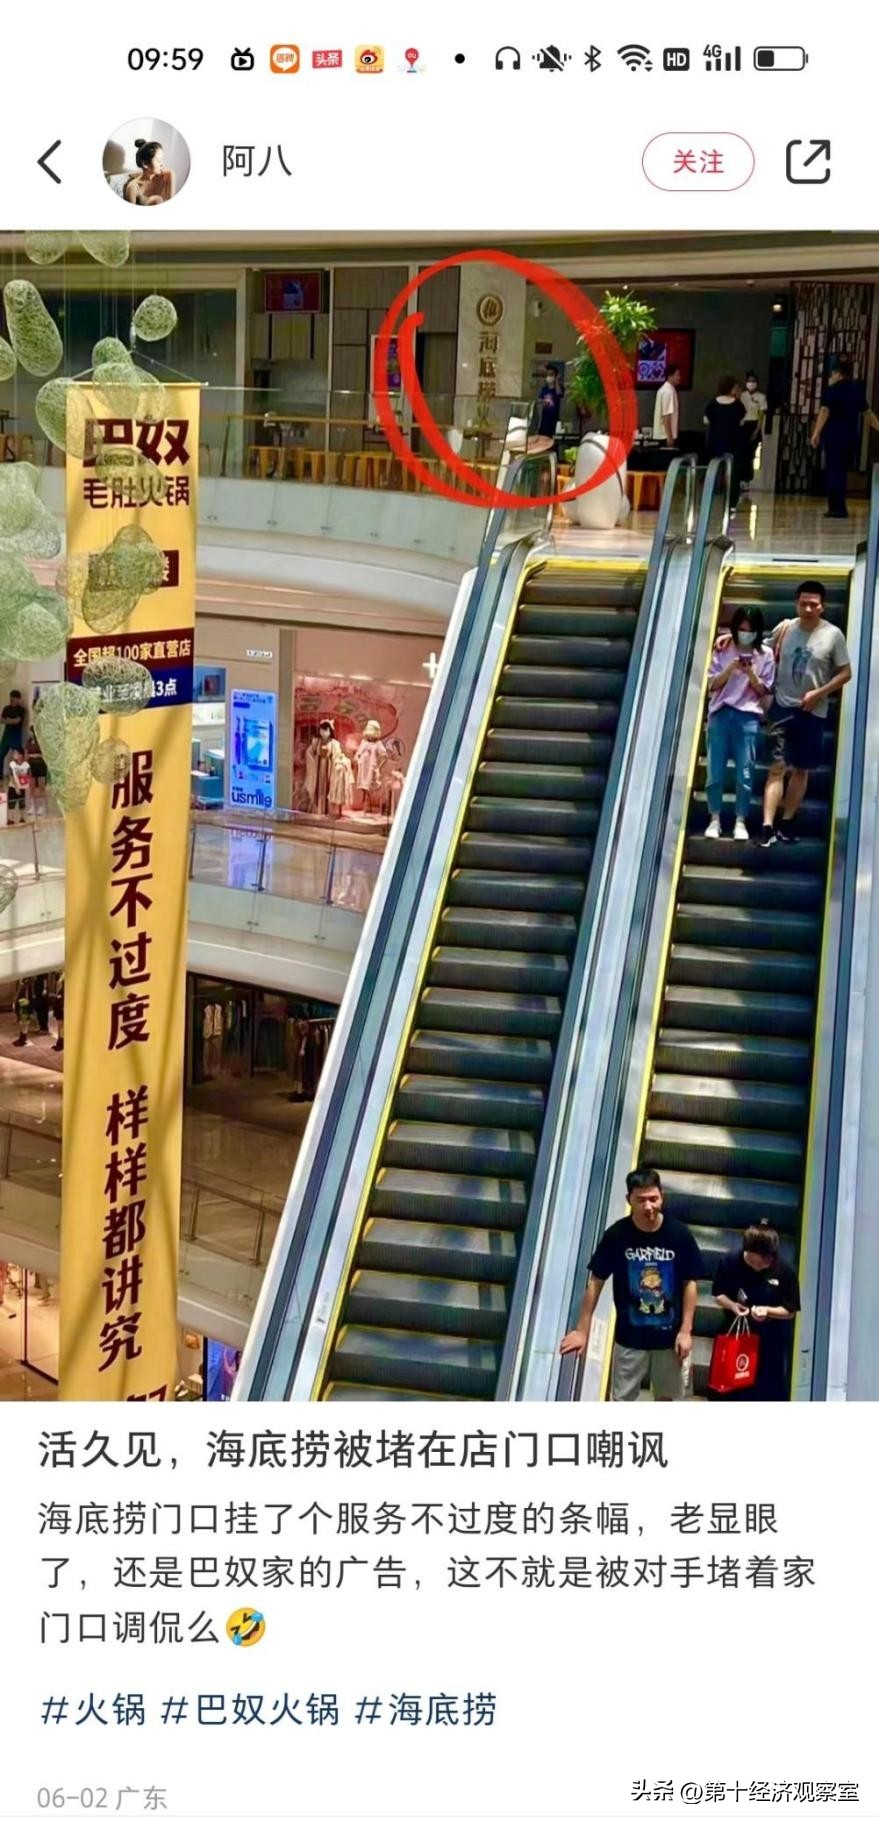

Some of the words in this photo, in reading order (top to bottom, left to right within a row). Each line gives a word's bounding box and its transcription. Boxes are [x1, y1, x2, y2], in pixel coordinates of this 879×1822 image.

[83, 417, 190, 468] 巴奴
[83, 475, 190, 509] 毛肚火锅
[231, 789, 273, 808] usmile
[108, 749, 154, 1050] 服务不过度
[98, 1085, 149, 1372] 样样都讲究
[625, 1246, 675, 1262] GARFIELD
